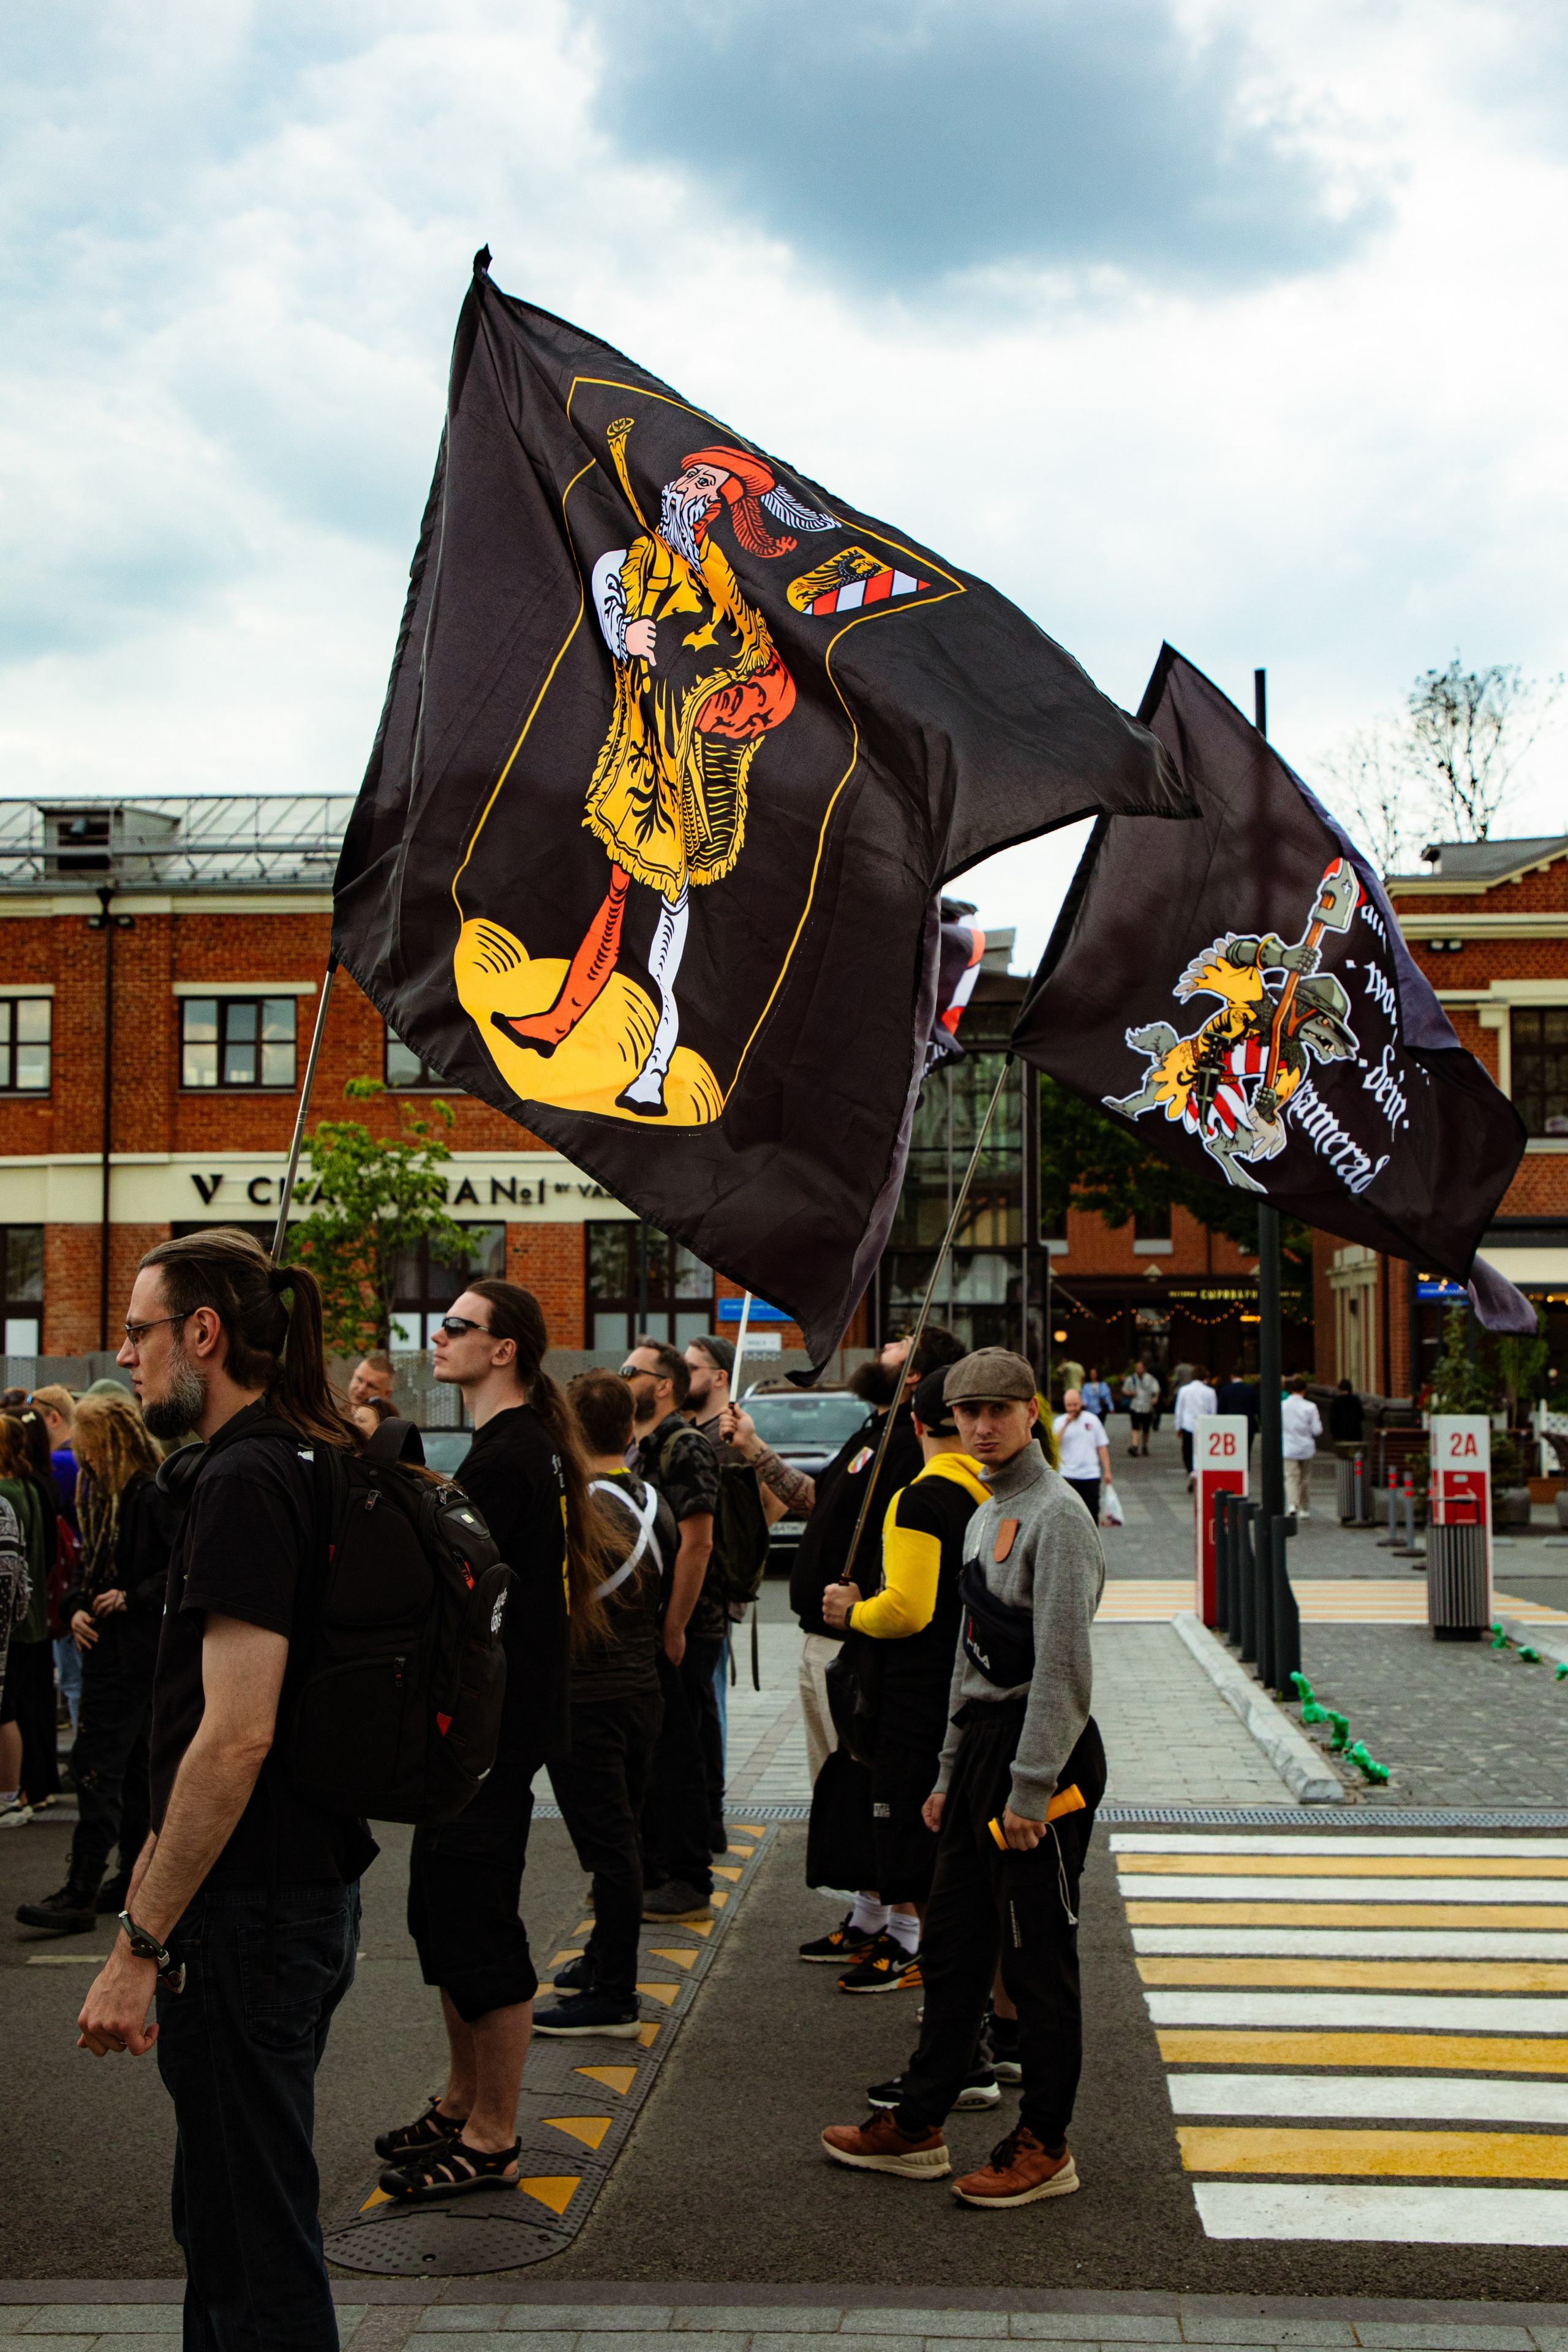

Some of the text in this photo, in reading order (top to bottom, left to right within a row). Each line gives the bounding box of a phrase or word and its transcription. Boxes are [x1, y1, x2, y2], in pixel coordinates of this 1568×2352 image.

[190, 1174, 224, 1205] V
[1200, 1289, 1257, 1300] СЫРОВАРН
[1208, 1432, 1236, 1457] 2B
[1450, 1432, 1478, 1457] 2A
